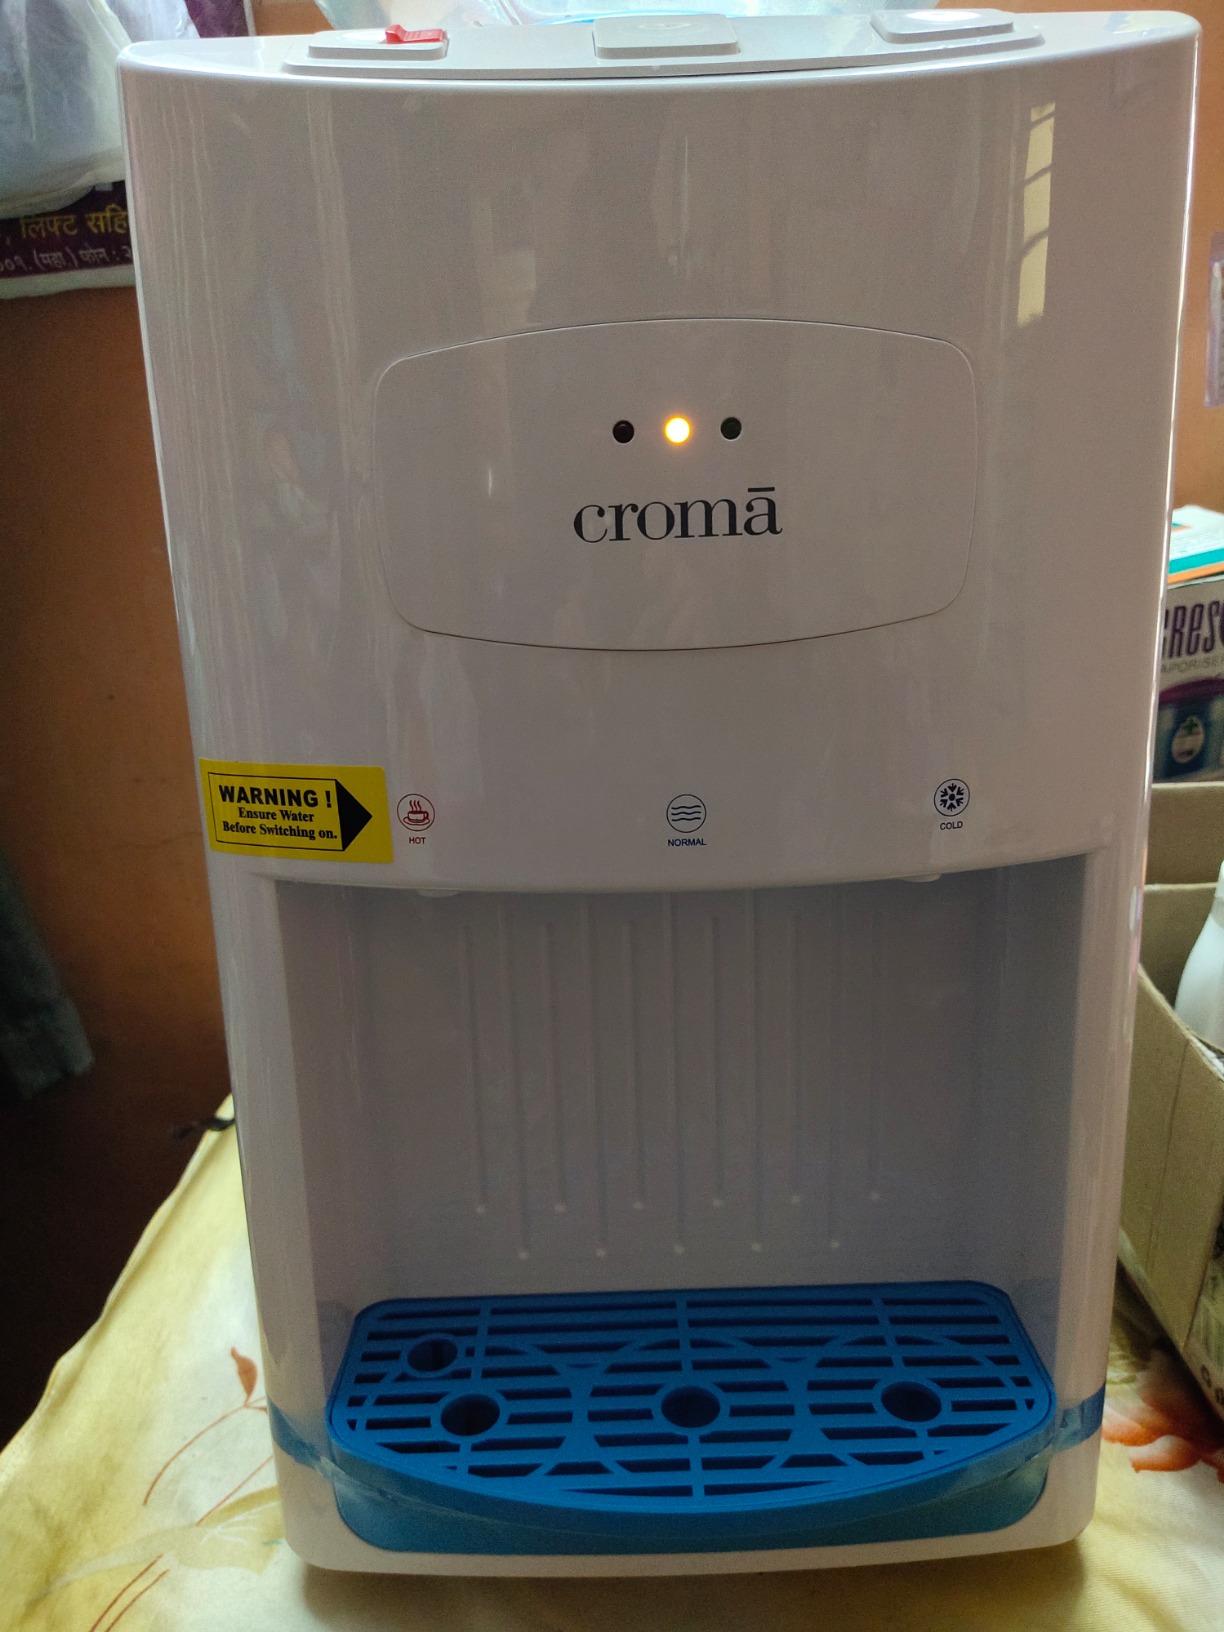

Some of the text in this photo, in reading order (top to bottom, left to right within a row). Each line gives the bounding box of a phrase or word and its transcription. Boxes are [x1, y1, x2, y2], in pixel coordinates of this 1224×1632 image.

[85, 203, 129, 234] सहि
[218, 784, 319, 808] WARNING
[238, 806, 315, 823] Ensure Water
[222, 820, 338, 841] Before Switching on.
[939, 820, 963, 831] COLD
[408, 835, 427, 845] HOT
[667, 837, 707, 848] NORMAL
